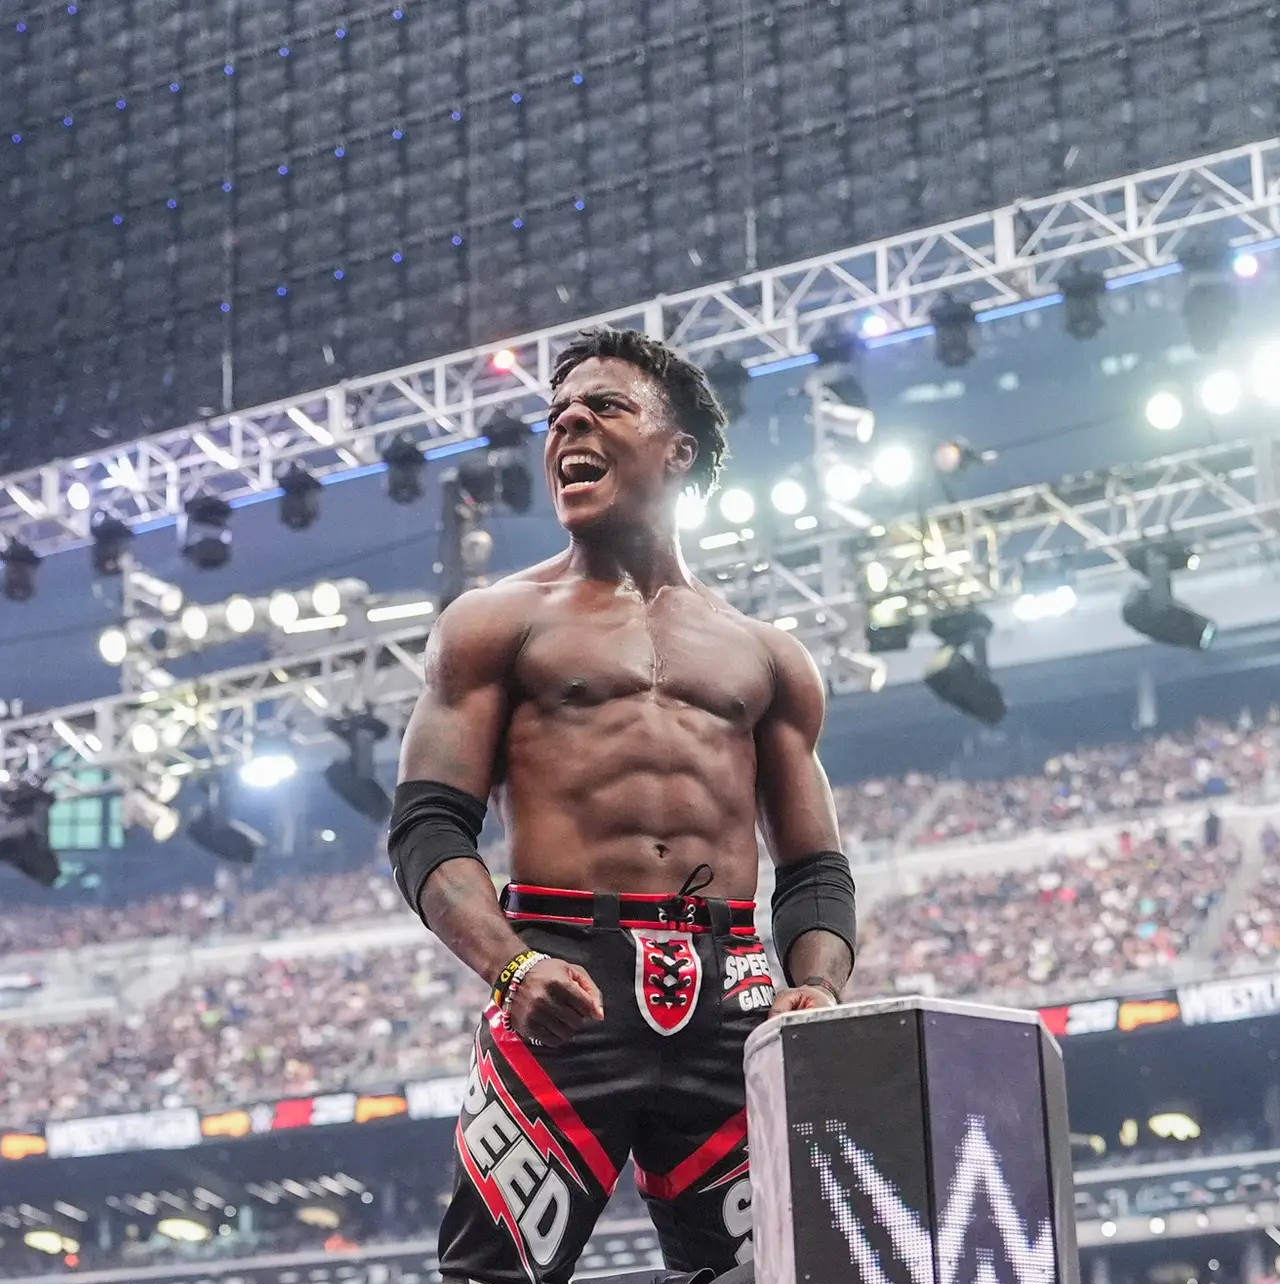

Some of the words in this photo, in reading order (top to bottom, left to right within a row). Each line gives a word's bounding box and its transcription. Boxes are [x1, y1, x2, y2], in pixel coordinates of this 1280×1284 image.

[723, 952, 772, 990] SPEE
[739, 985, 775, 1011] GAN
[463, 1046, 570, 1266] PEED
